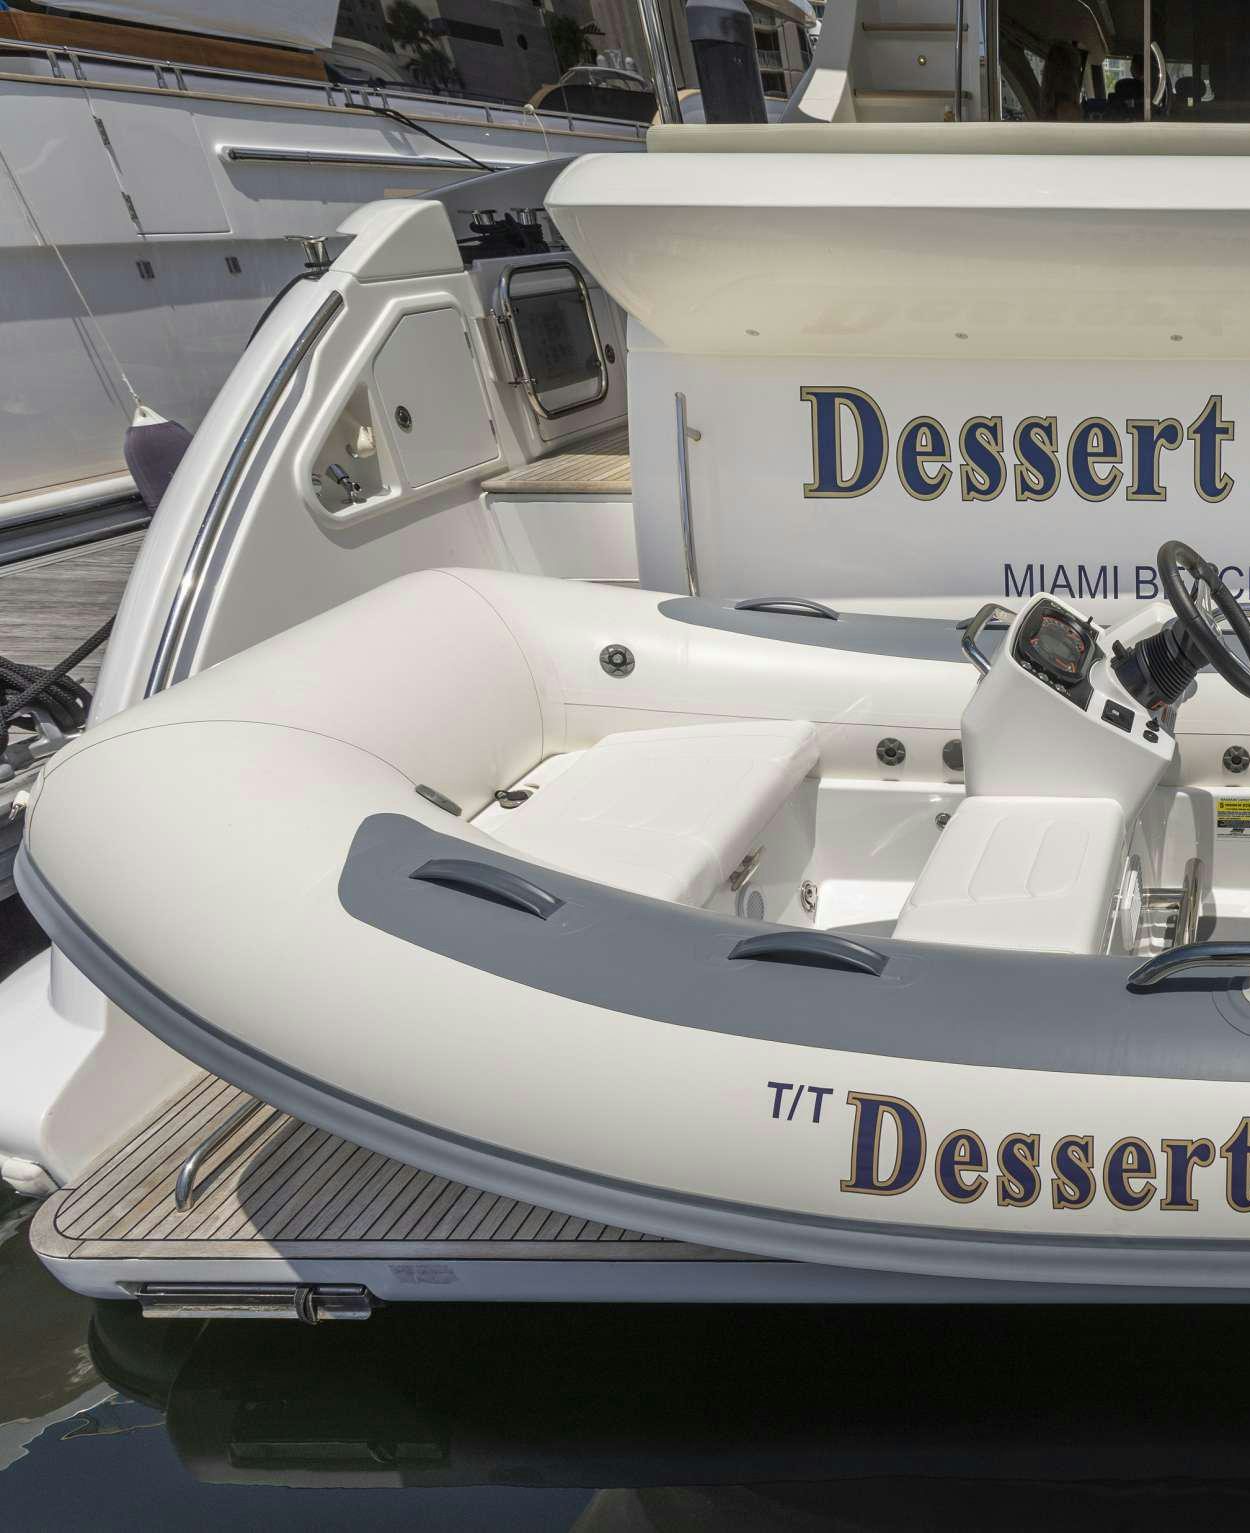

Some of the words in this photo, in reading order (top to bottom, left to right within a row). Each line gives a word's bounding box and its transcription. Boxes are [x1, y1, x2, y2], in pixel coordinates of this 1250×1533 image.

[800, 386, 1235, 503] Dessert
[1003, 563, 1119, 600] MIAMI
[767, 1081, 834, 1124] T/T
